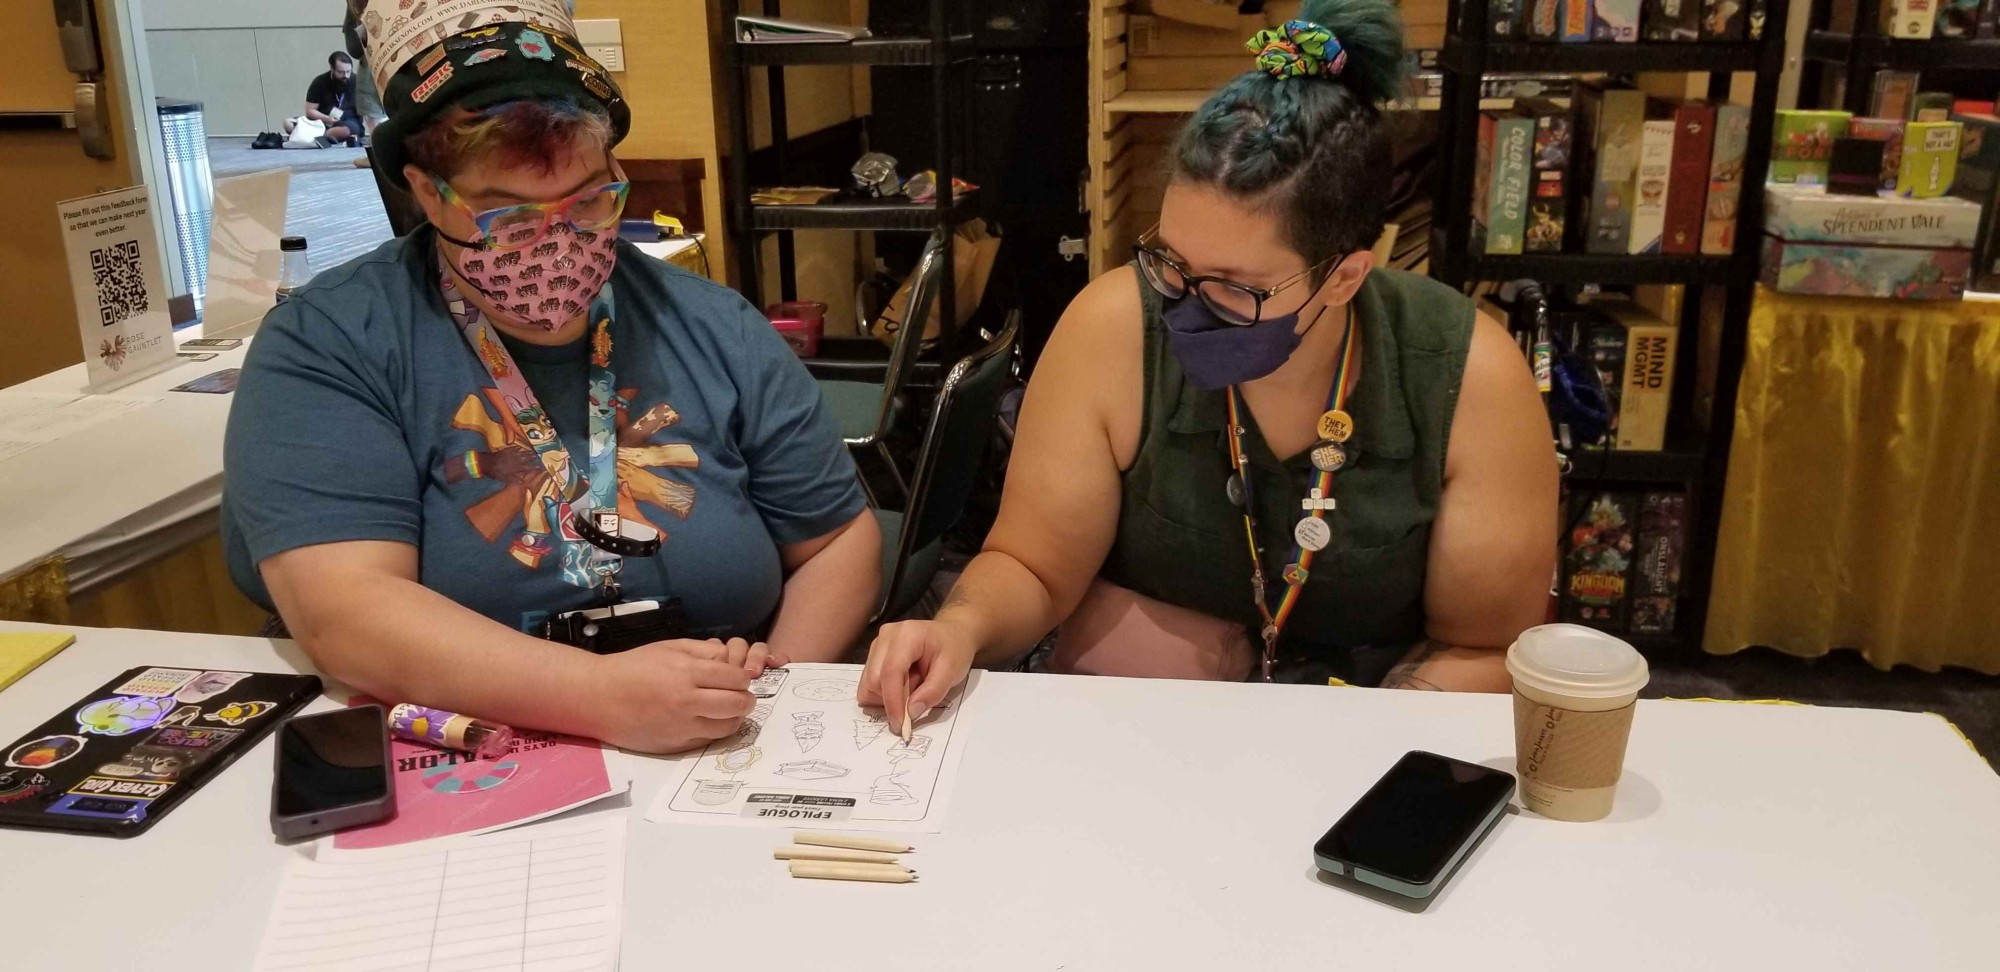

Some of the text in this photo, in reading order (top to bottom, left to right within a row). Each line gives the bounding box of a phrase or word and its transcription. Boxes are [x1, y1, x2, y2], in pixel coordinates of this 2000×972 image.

[412, 63, 452, 99] RISK
[1509, 127, 1525, 171] COLOR
[1504, 176, 1522, 220] FIELD
[63, 210, 82, 220] Please
[82, 207, 90, 216] fill
[100, 204, 111, 212] this
[111, 198, 135, 209] feedback
[108, 214, 122, 222] make
[124, 210, 134, 218] next
[135, 208, 146, 218] year
[96, 224, 127, 238] even better.
[1823, 214, 1946, 235] SPLENDENT VALE
[126, 332, 144, 344] ROSE
[128, 336, 162, 354] GAUNTLET
[1632, 336, 1650, 389] MGMT
[1648, 336, 1667, 389] MIND
[1324, 416, 1346, 430] THEY
[1324, 424, 1346, 438] THEM
[1312, 444, 1336, 460] SHE
[1320, 453, 1344, 468] HER
[1654, 536, 1668, 593] ONSLAUGHT
[524, 740, 556, 752] DAYS
[78, 778, 168, 798] CLEVER GIRL
[757, 808, 832, 819] EPILOGUE
